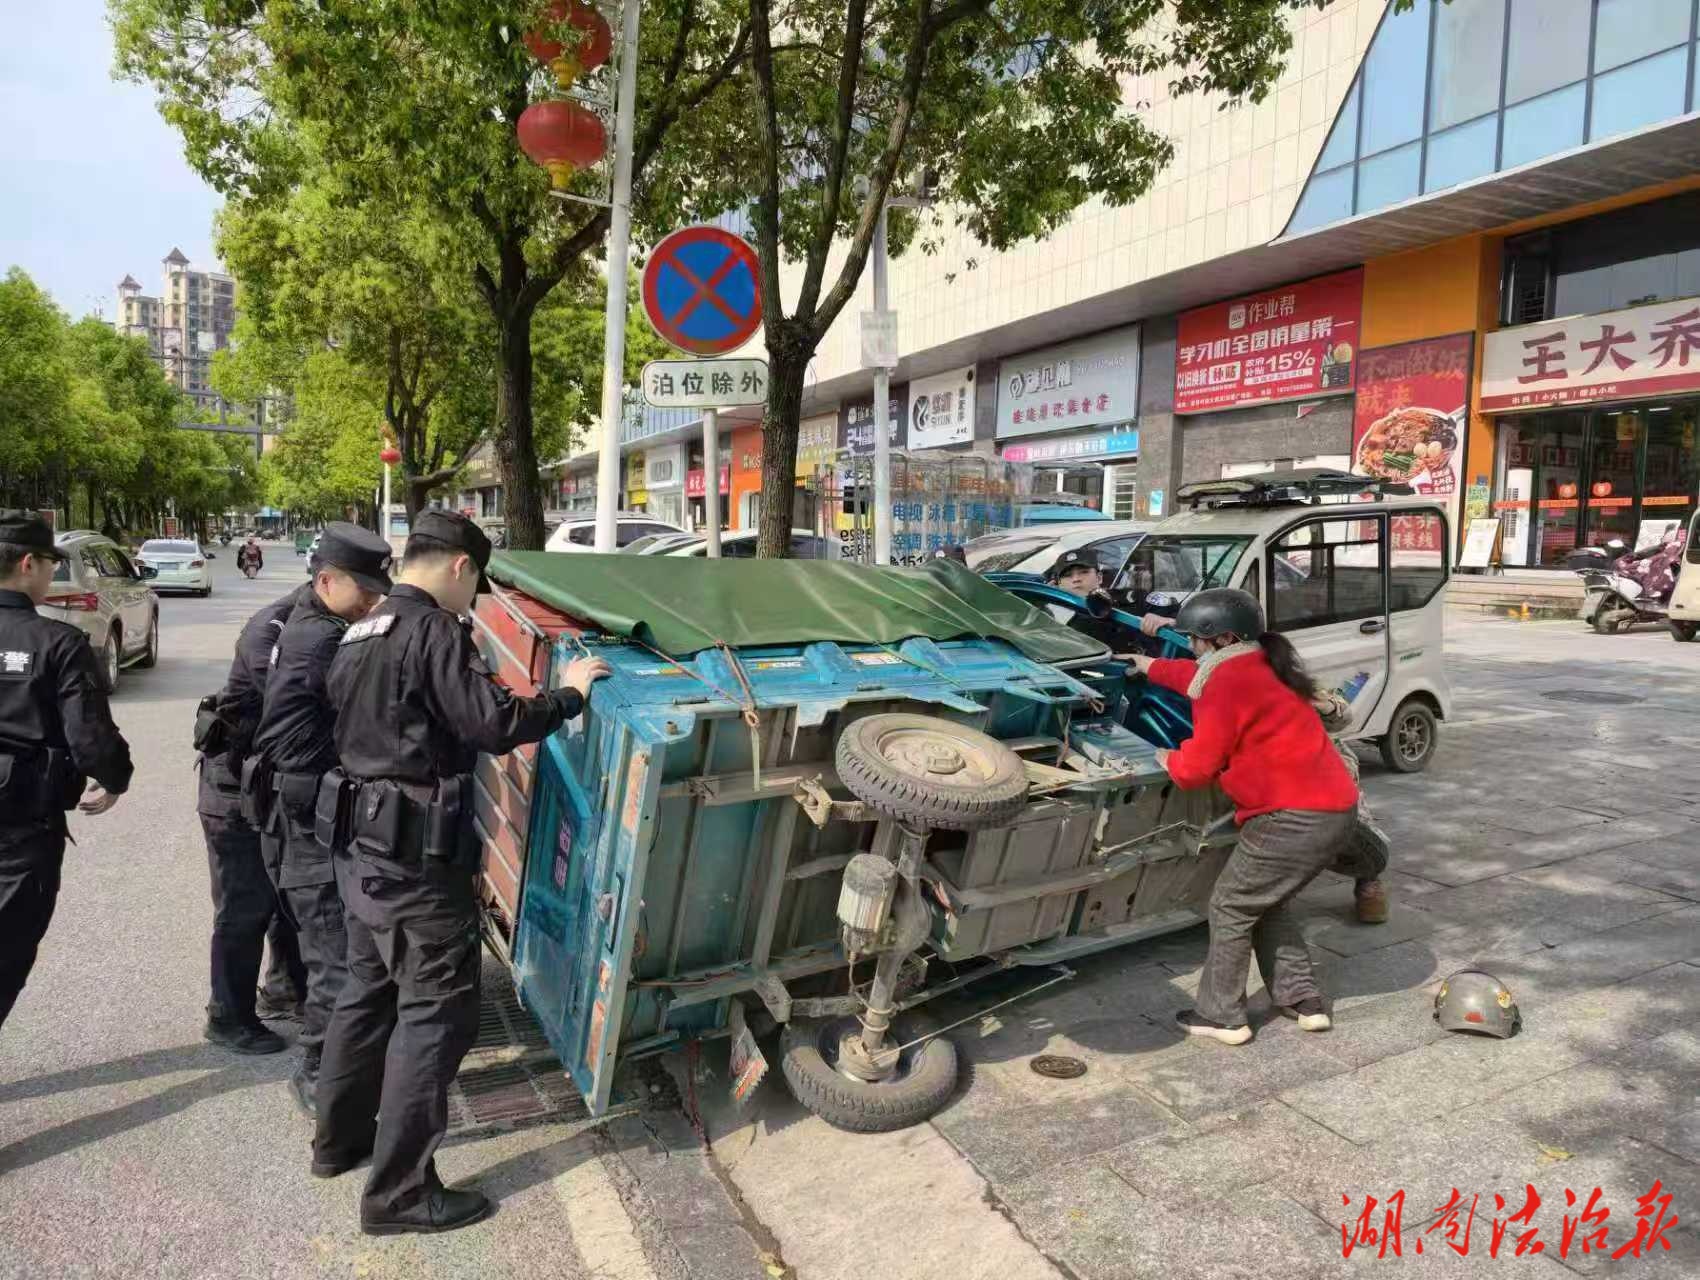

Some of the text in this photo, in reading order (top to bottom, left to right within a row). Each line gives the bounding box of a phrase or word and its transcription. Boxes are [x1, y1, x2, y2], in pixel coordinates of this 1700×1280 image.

[1249, 294, 1296, 325] 作业帮
[1180, 316, 1355, 365] 学习机全国销量第一
[1517, 307, 1700, 385] 王大乔
[1266, 348, 1316, 373] 15%
[652, 370, 763, 396] 泊位除外
